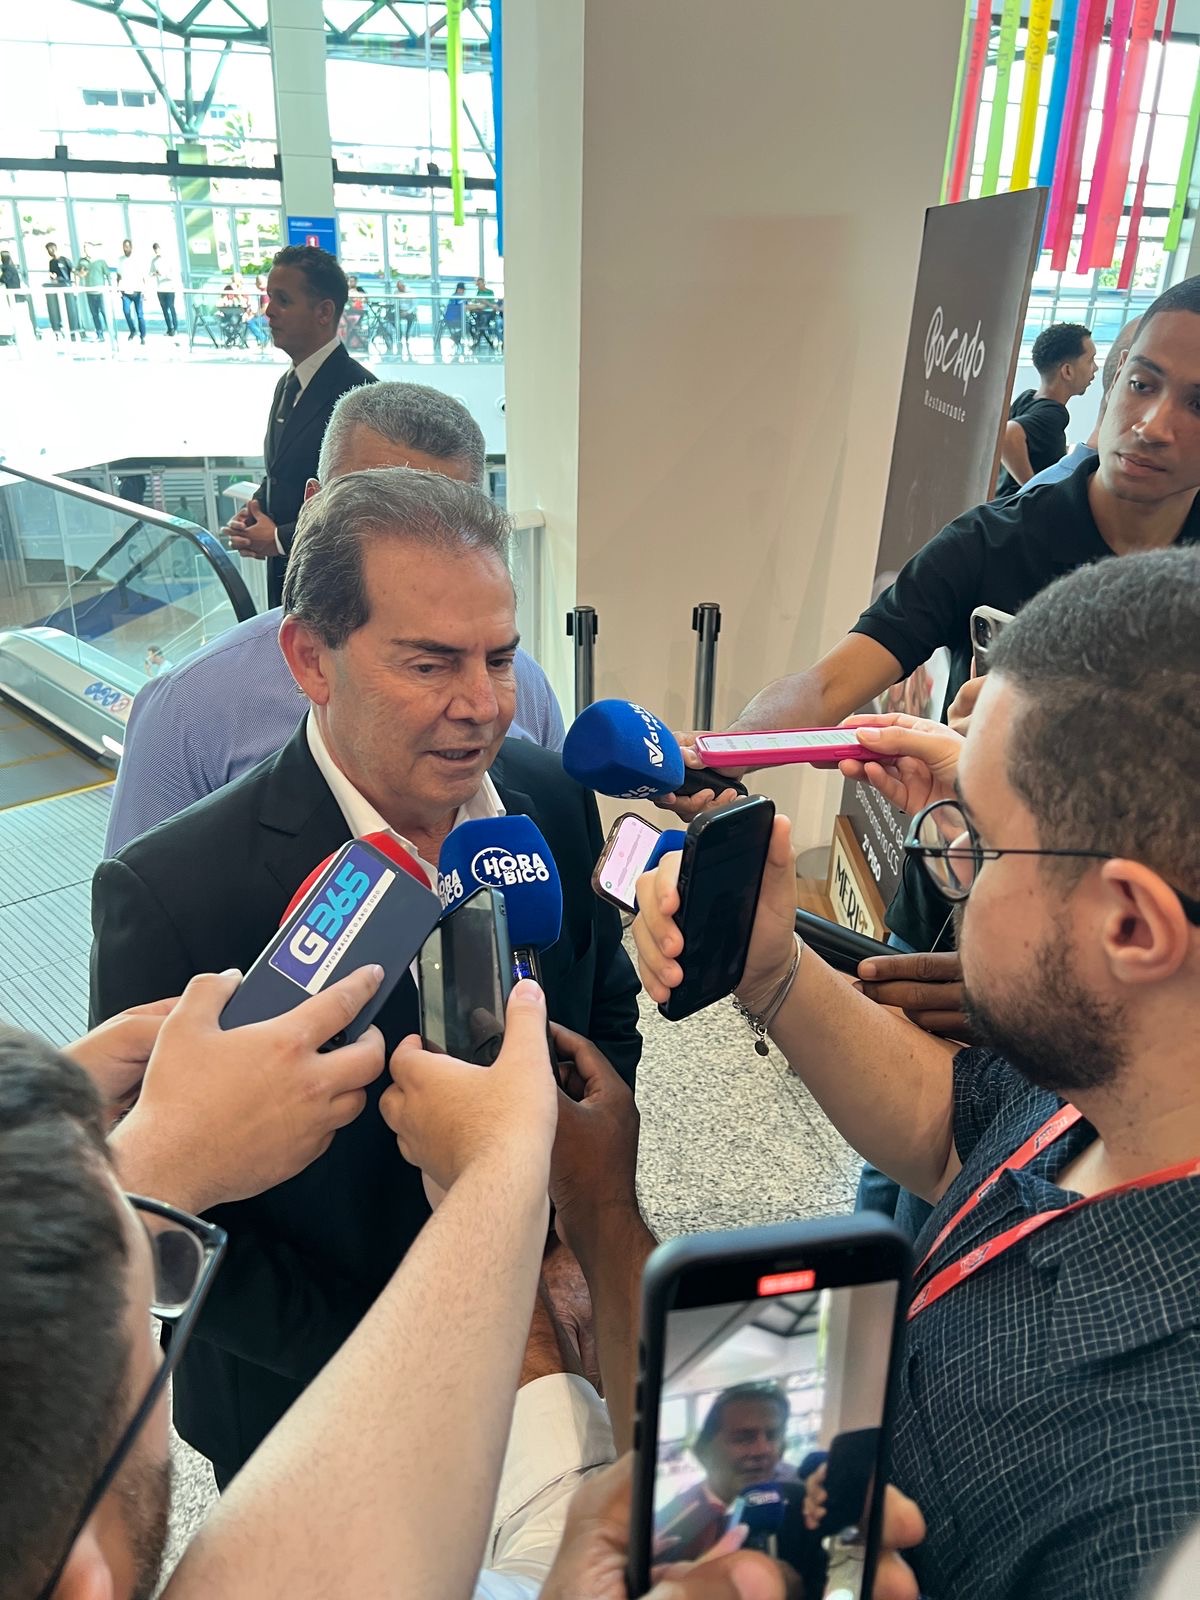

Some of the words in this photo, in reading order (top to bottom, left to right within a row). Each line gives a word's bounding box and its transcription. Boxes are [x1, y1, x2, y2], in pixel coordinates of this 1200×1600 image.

[924, 389, 966, 423] Restaurante
[879, 796, 897, 835] melhor
[896, 825, 904, 850] da
[483, 853, 547, 879] HORA
[887, 842, 900, 876] CCS
[439, 868, 462, 896] ORA
[503, 868, 550, 886] BICO
[289, 861, 370, 965] G365
[323, 929, 354, 972] INFORMAÇÃO
[358, 907, 369, 922] ANO
[367, 889, 381, 907] TODO
